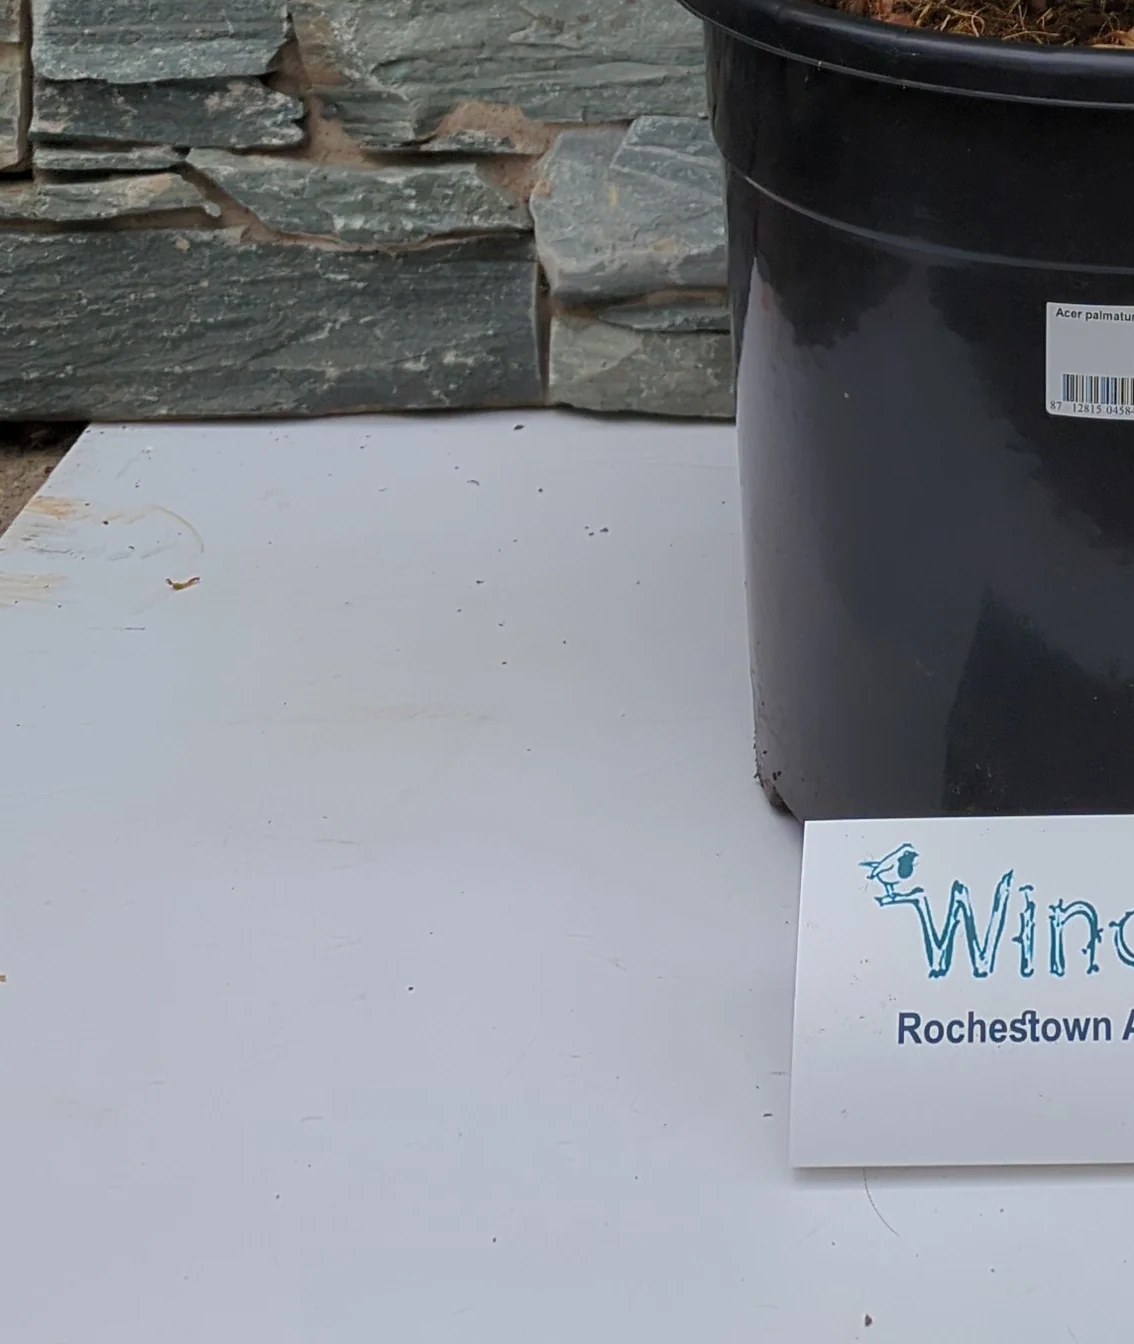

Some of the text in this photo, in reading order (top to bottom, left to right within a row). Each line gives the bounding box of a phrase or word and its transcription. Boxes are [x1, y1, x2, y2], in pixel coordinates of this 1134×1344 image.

[1055, 307, 1083, 319] Acer
[1049, 400, 1062, 410] 87
[1073, 402, 1102, 413] 12815
[897, 1008, 1113, 1045] Rochestown
